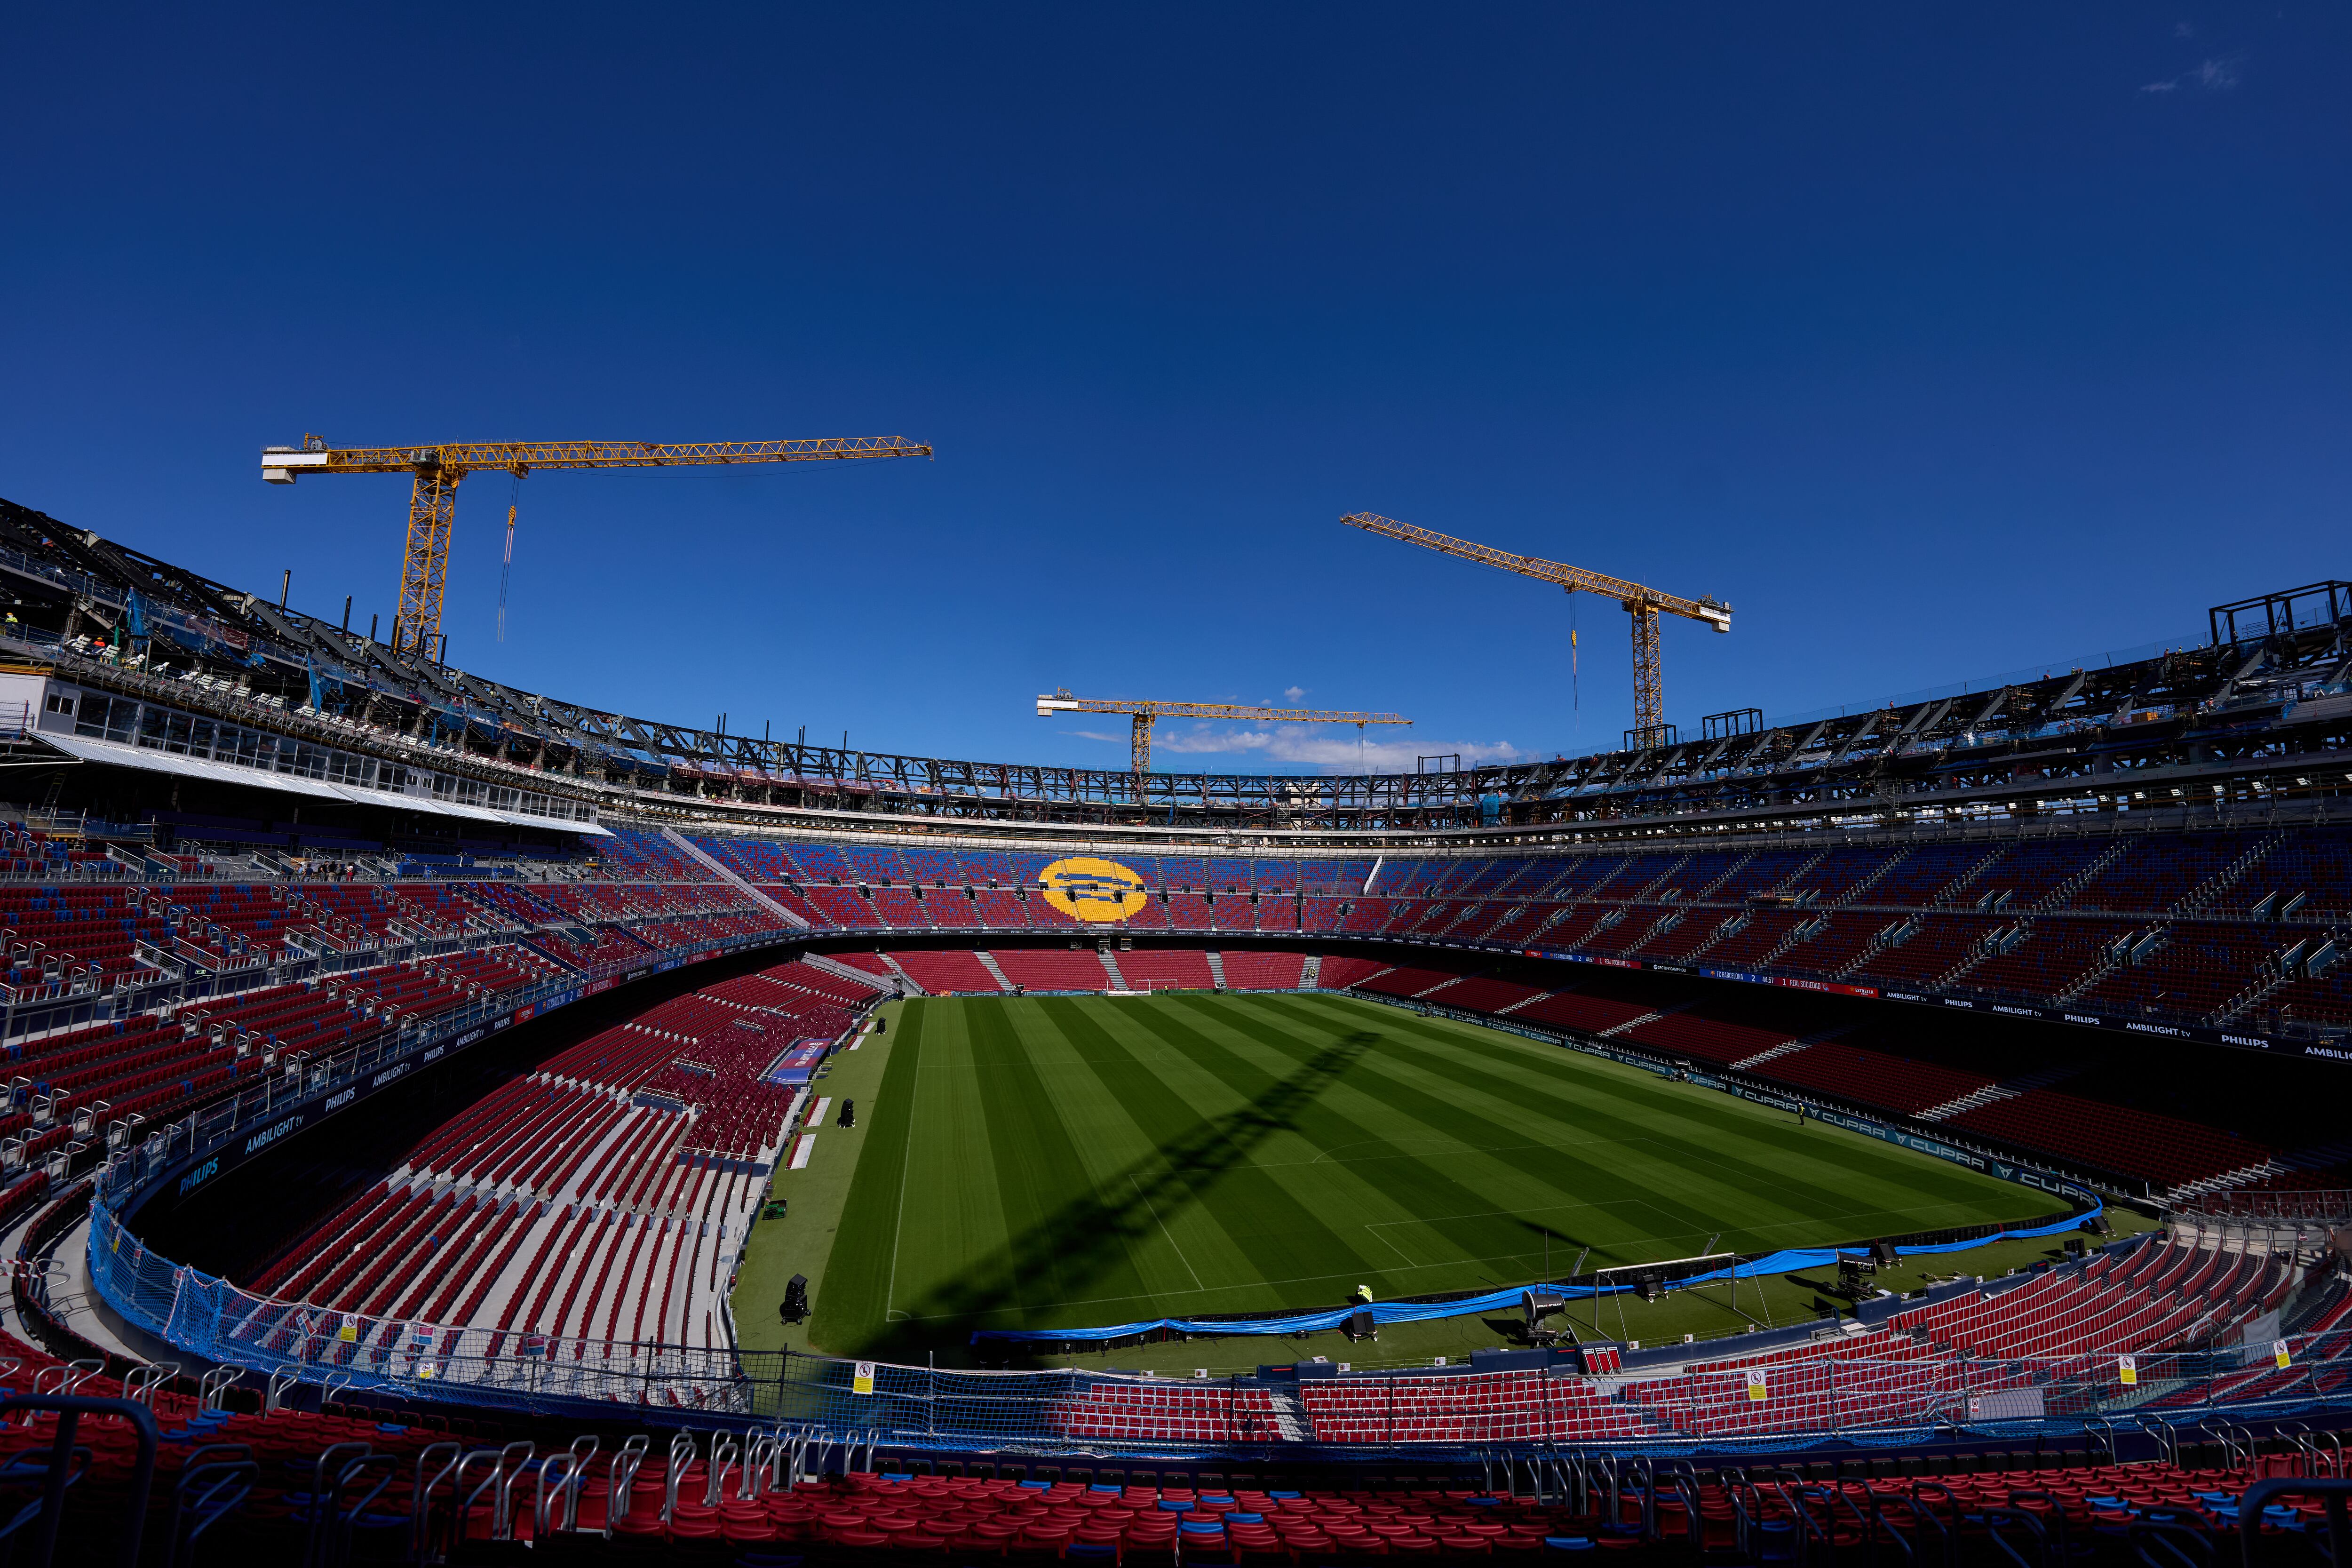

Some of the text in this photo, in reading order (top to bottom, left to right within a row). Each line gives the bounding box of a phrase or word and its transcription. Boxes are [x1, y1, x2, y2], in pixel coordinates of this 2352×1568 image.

[1722, 971, 1743, 980] BARCELONA
[570, 991, 573, 1001] 2
[588, 985, 590, 995] 1
[1887, 992, 1919, 1001] AMBILIGHT
[550, 994, 565, 1008] BARCELONA
[1391, 1002, 1414, 1010] CUPRA
[1945, 999, 1972, 1008] PHILIPS
[1422, 1008, 1446, 1017] CPRA
[1993, 1005, 2032, 1016] AMBILIGHT
[494, 1016, 510, 1030] PHILIPS
[1456, 1016, 1482, 1025] CUPRA
[2065, 1014, 2100, 1025] PHILIPS
[1493, 1024, 1521, 1035] CUPRA
[2126, 1022, 2178, 1035] AMBILIGHT
[456, 1029, 479, 1047] AMBILIGHT
[1531, 1034, 1561, 1045] CUPRA
[2221, 1034, 2269, 1048] PHILIPS
[424, 1045, 444, 1062] PHILIPS
[1574, 1044, 1610, 1058] CUPRA
[1626, 1057, 1665, 1073] CUPRA
[373, 1063, 404, 1088] AMBILIGHT
[1687, 1074, 1726, 1090] UPRA
[326, 1087, 355, 1112] PHILIPS
[1745, 1091, 1797, 1112] CUPRA
[1822, 1113, 1885, 1138] CUPRA
[245, 1115, 294, 1155] AMBILIGHT
[1910, 1138, 1984, 1169] CUPRA
[179, 1157, 218, 1196] PHILIPS
